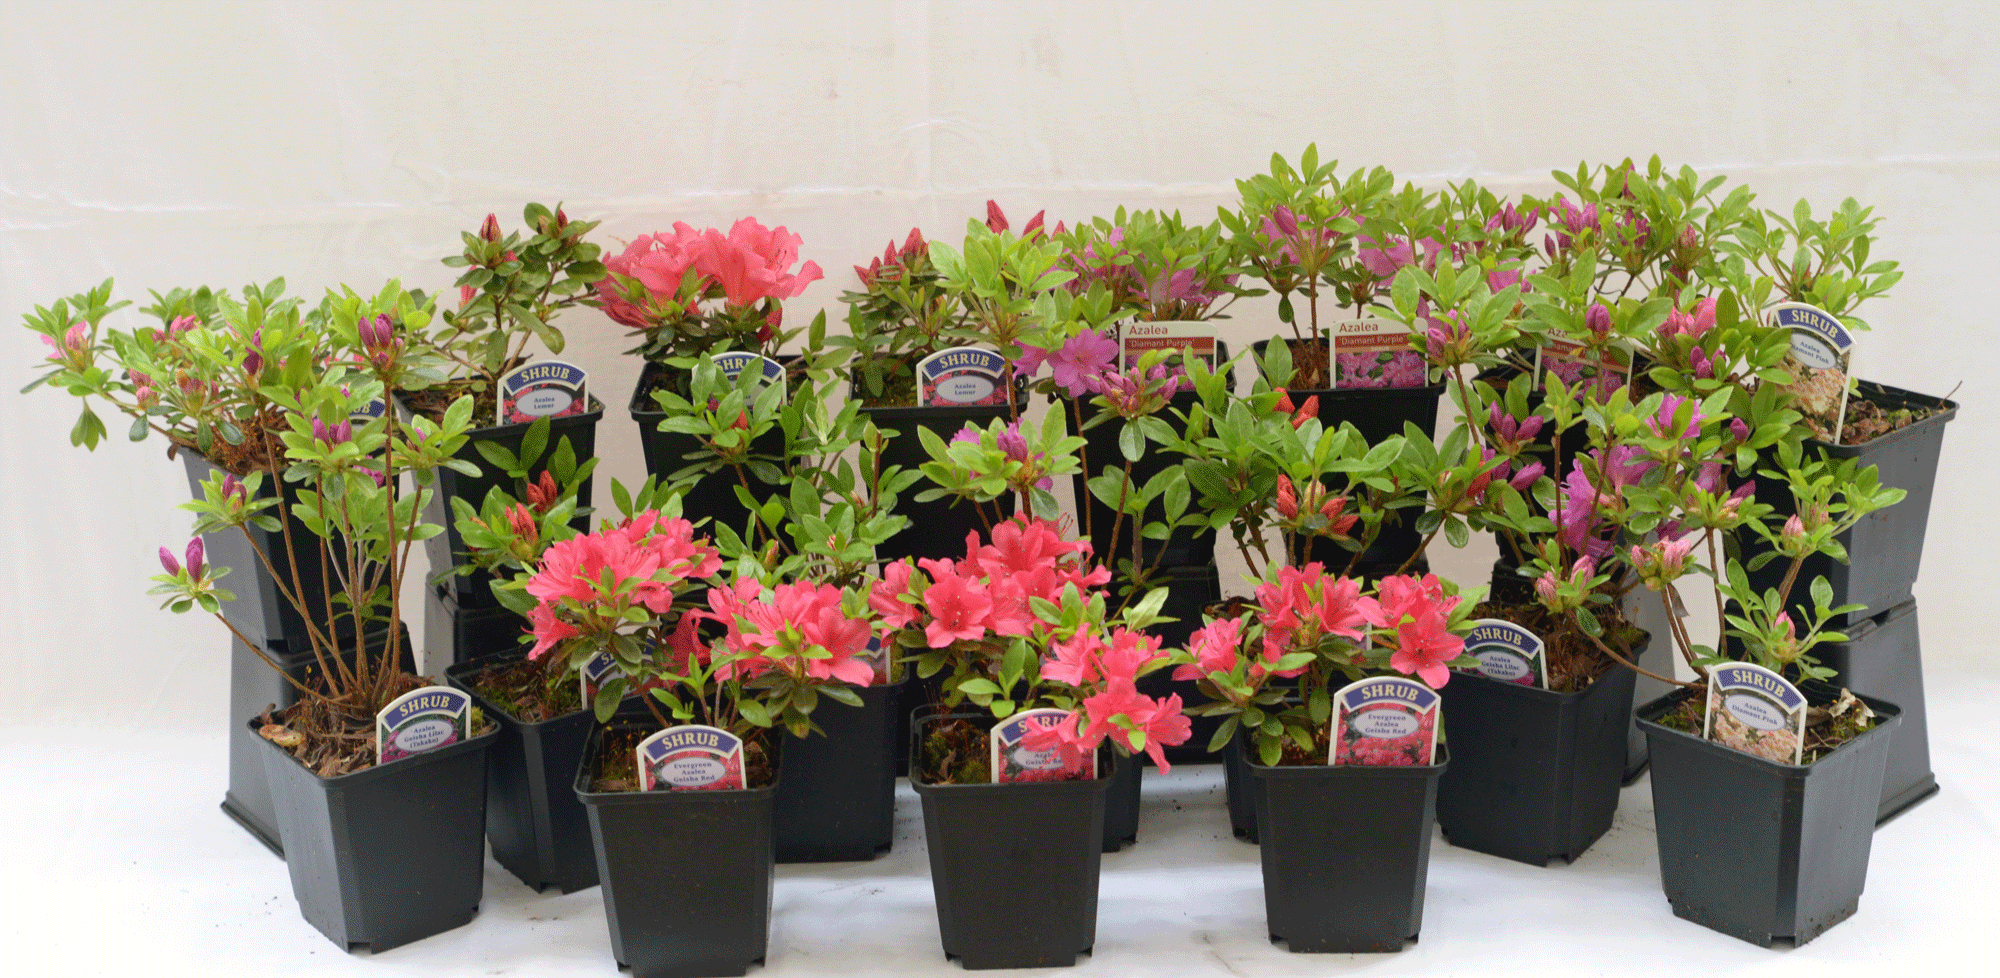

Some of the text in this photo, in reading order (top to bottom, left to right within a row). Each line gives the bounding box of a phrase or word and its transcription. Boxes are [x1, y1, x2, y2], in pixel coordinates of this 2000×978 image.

[1129, 325, 1168, 335] Azalea
[1338, 322, 1379, 333] Azalea
[1791, 309, 1839, 338] SHRUB
[1790, 344, 1829, 364] iamant Pink
[1800, 341, 1820, 353] Azalea
[939, 353, 990, 369] SHRUB
[521, 366, 570, 383] SHRUB
[1473, 627, 1522, 645] SHRUB
[1490, 655, 1511, 663] Azalea
[1733, 670, 1785, 697] SHRUB
[1361, 684, 1419, 701] SHRUB
[400, 696, 450, 717] SHRUB
[1745, 702, 1767, 714] Azalea
[1762, 715, 1778, 725] Pink
[414, 725, 435, 733] Azalea
[662, 733, 719, 750] SHRUB
